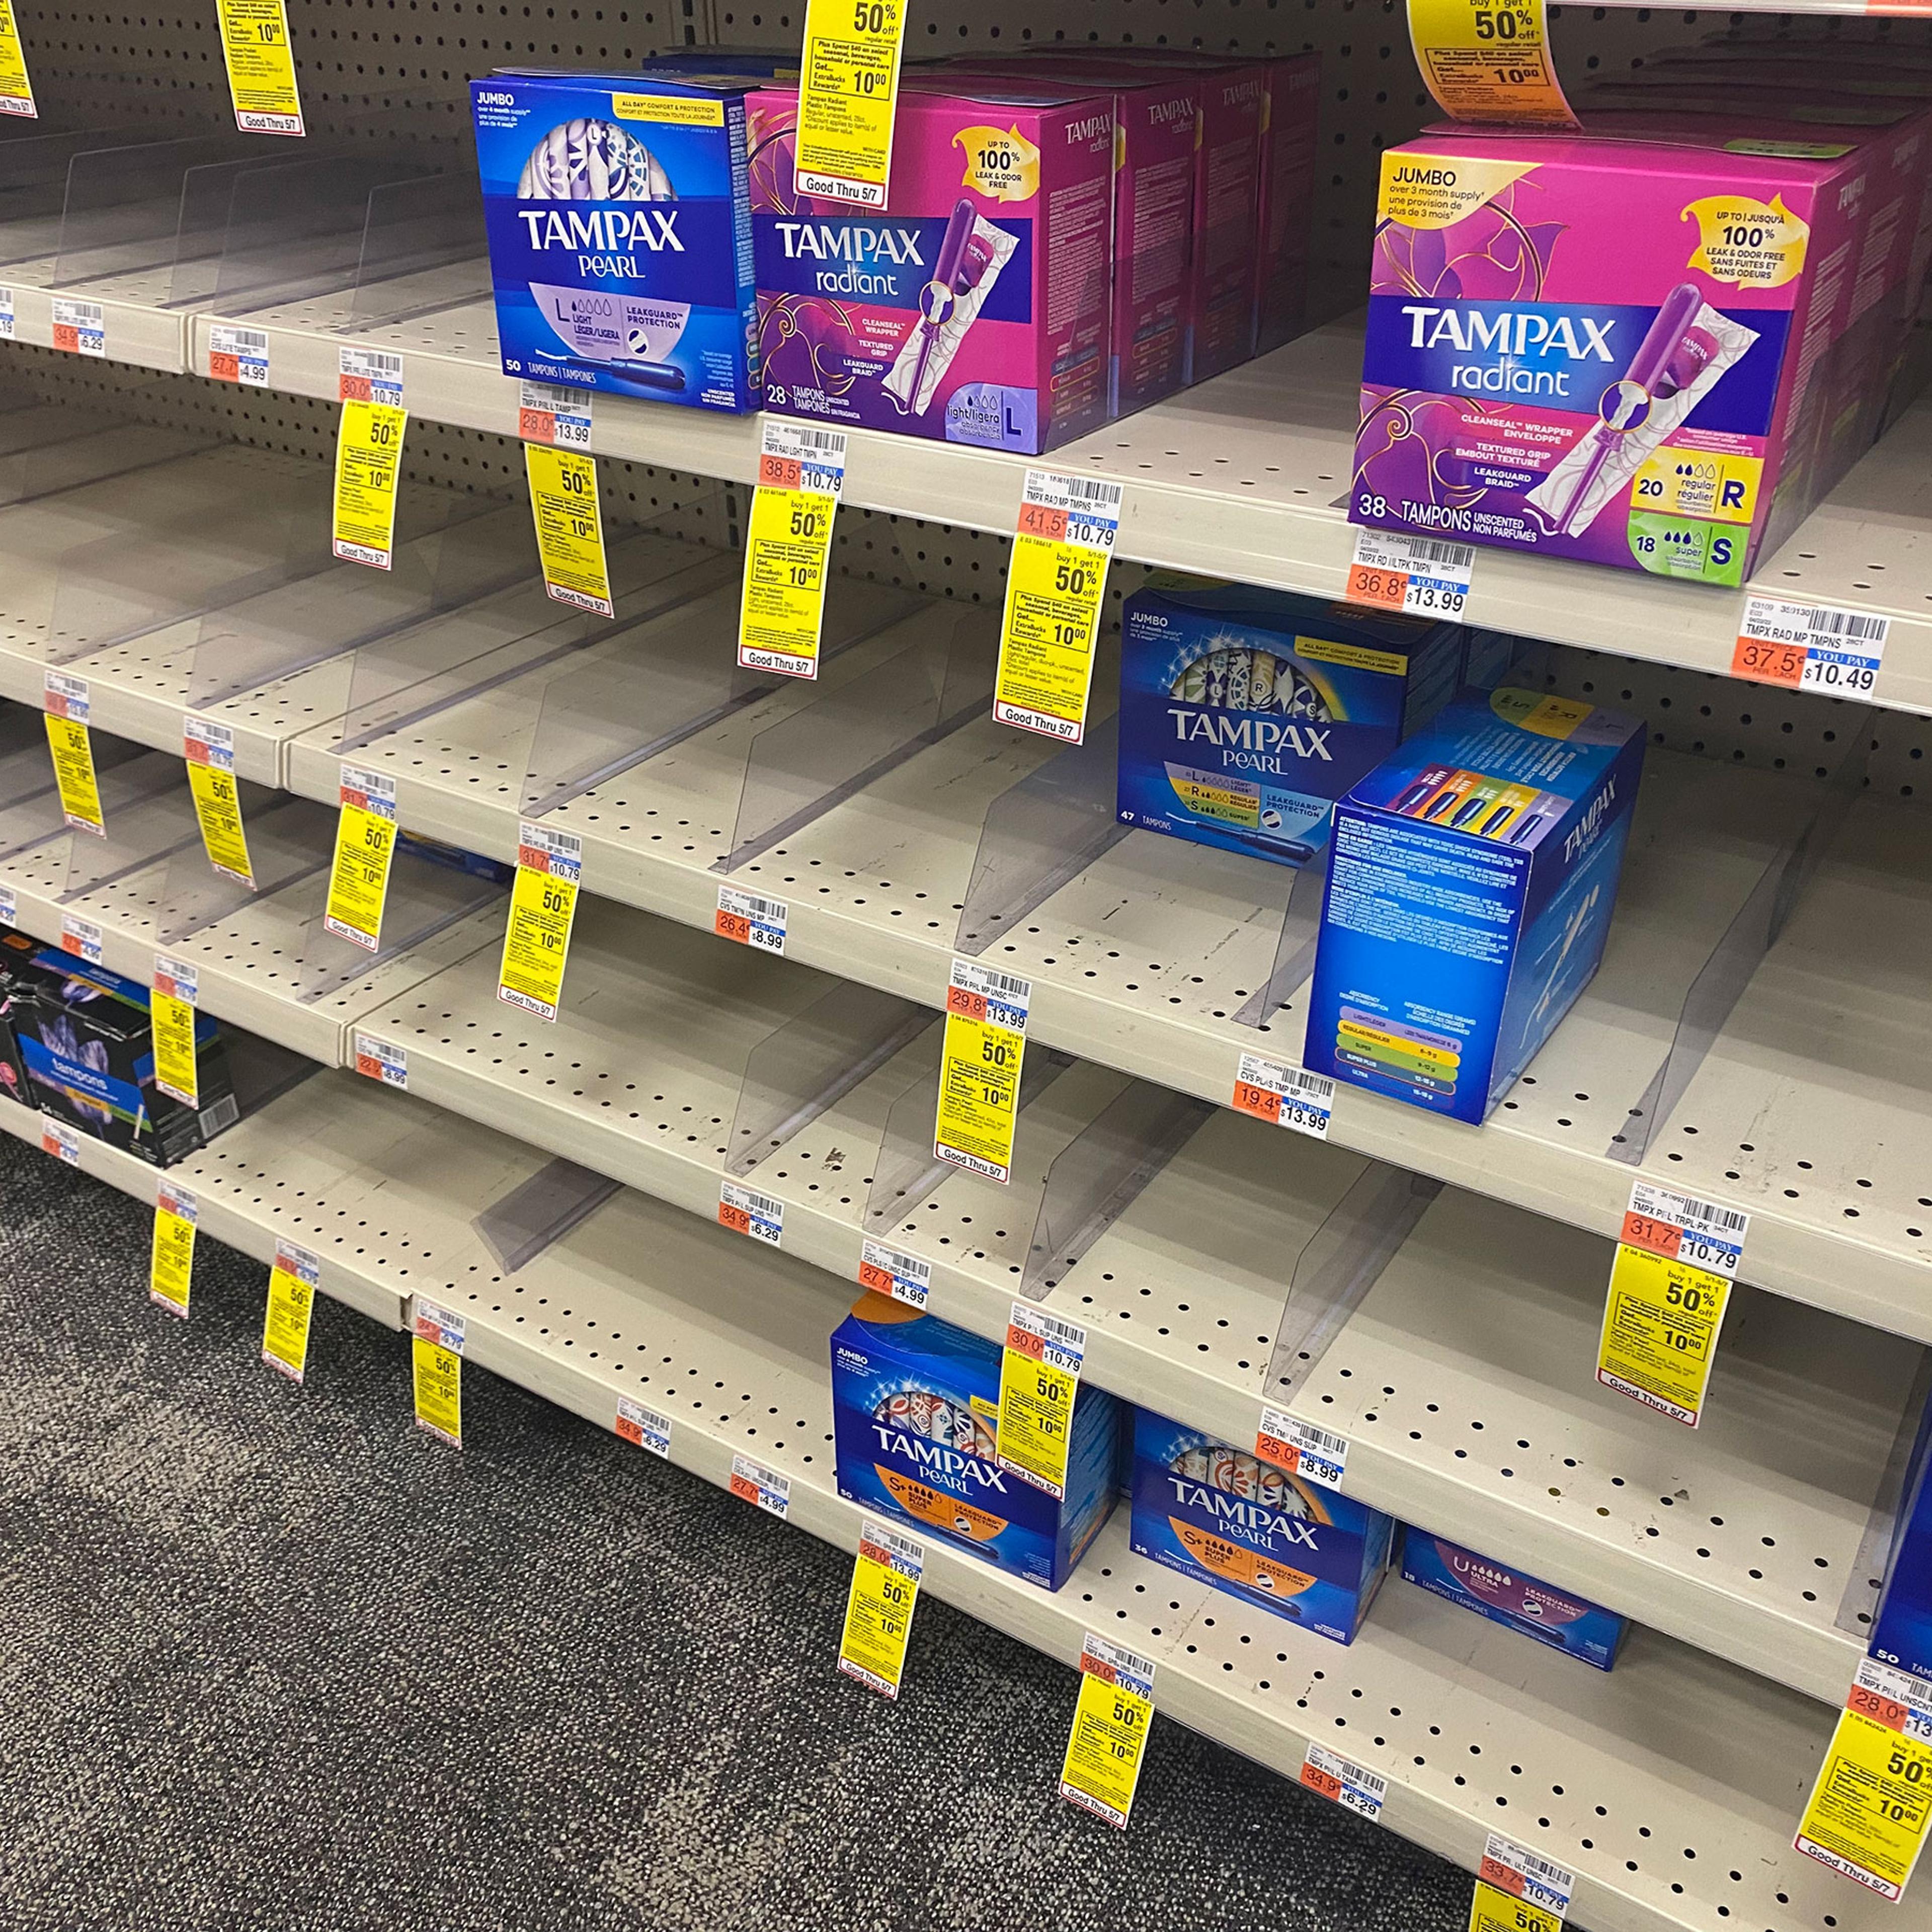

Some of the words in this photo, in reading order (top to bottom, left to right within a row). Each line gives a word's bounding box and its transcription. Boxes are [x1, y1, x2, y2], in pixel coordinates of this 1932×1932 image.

[851, 60, 875, 68] personal
[477, 92, 514, 106] JUMBO
[680, 105, 715, 113] PROTECTION
[1065, 114, 1111, 144] TAMPAX
[978, 150, 1020, 170] 100%
[1001, 174, 1022, 182] ODOR
[1393, 167, 1456, 187] JUMBO
[807, 178, 833, 193] Good
[836, 183, 859, 198] Thru
[862, 188, 877, 200] 5/7
[1390, 185, 1409, 193] over
[1419, 188, 1448, 196] month
[1407, 198, 1448, 208] provision
[1450, 202, 1462, 210] de
[1731, 213, 1741, 221] TO
[1747, 214, 1785, 224] JUSQU'À
[518, 211, 685, 251] TAMPAX
[1723, 226, 1775, 247] 100%
[774, 222, 925, 266] TAMPAX
[1707, 248, 1728, 256] LEAK
[1737, 250, 1761, 259] ODOR
[1763, 253, 1785, 261] FREE
[1711, 258, 1733, 266] SANS
[1735, 260, 1764, 268] FUITES
[816, 263, 899, 295] radiant
[1712, 268, 1735, 276] SANS
[1737, 270, 1771, 279] ODEURS
[556, 298, 570, 322] L
[572, 314, 592, 325] LIGHT
[628, 315, 680, 329] PROTECTION
[865, 326, 899, 337] WRAPPER
[1402, 306, 1616, 363] TAMPAX
[858, 340, 894, 351] TEXTURED
[506, 359, 521, 371] 50
[528, 363, 557, 378] TAMPONS
[562, 367, 596, 384] TAMPONES
[843, 359, 883, 371] LEAKGUARD
[1452, 357, 1570, 396] radiant
[767, 384, 786, 405] 28
[792, 385, 825, 401] TAMPONS
[793, 397, 830, 414] TAMPONES
[947, 405, 999, 423] light/ligera
[1006, 408, 1021, 436] L
[1525, 423, 1573, 437] WRAPPER
[1504, 430, 1561, 444] ENVELOPPE
[1456, 448, 1495, 460] EMBOUT
[1497, 454, 1540, 467] TEXTURÉ
[1477, 442, 1525, 455] TEXTURED
[1527, 451, 1551, 459] GRIP
[801, 474, 841, 492] $10.79
[1474, 467, 1532, 482] LEAKGUARD
[1026, 490, 1043, 502] TMPX
[1044, 494, 1058, 504] RAD
[1060, 497, 1069, 506] MP
[1070, 500, 1091, 511] TMPNS
[1639, 479, 1663, 496] 20
[1681, 479, 1716, 491] regular
[1721, 480, 1745, 509] R
[1074, 513, 1091, 524] YOU
[1092, 518, 1110, 527] PAY
[1358, 494, 1386, 517] 38
[1402, 501, 1471, 531] TAMPONS
[1474, 513, 1524, 529] UNSCENTED
[1067, 524, 1114, 546] $10.79
[1473, 523, 1491, 534] NON
[1493, 526, 1537, 542] PARFUMÉS
[1637, 536, 1655, 552] 18
[1676, 546, 1702, 557] super
[1711, 538, 1732, 565] S
[1358, 552, 1376, 562] TMPX
[1377, 556, 1387, 566] RD
[1412, 562, 1431, 573] TMPN
[1416, 578, 1439, 589] YOU
[1440, 582, 1460, 592] PAY
[1406, 587, 1463, 612] $13.99
[1131, 612, 1168, 627] JUMBO
[1746, 623, 1770, 637] TMPX
[1772, 628, 1792, 640] RAD
[1793, 632, 1808, 642] MP
[1810, 634, 1841, 649] TMPNS
[1805, 663, 1873, 690] $10.49
[1006, 708, 1033, 726] Good
[1034, 715, 1057, 732] Thru
[1058, 721, 1073, 736] 5/7
[1167, 708, 1333, 761] TAMPAX
[1266, 802, 1320, 817] PROTECTION
[1120, 811, 1135, 820] 47
[1143, 816, 1171, 830] TAMPONS
[752, 933, 782, 948] $8.99
[987, 1007, 1025, 1029] $13.99
[1241, 1071, 1254, 1082] CVS
[1275, 1082, 1289, 1092] TMP
[1291, 1088, 1300, 1096] MP
[1280, 1107, 1326, 1131] $13.99
[751, 1224, 778, 1241] $6.29
[1680, 1242, 1737, 1269] $10.79
[895, 1285, 924, 1304] $4.99
[837, 1347, 868, 1365] JUMBO
[1044, 1348, 1081, 1372] $10.79
[1610, 1378, 1639, 1398] Good
[1642, 1393, 1668, 1412] Thru
[1670, 1406, 1687, 1420] 5/7
[1263, 1424, 1274, 1433] CVS
[1290, 1435, 1303, 1445] UNS
[1304, 1441, 1317, 1450] SUP
[871, 1424, 1007, 1494] TAMPAX
[1301, 1460, 1338, 1482] $8.99
[840, 1489, 853, 1499] 50
[908, 1491, 932, 1506] SUPER
[909, 1498, 927, 1510] PLUS
[1168, 1477, 1319, 1551] TAMPAX
[1205, 1546, 1230, 1561] SUPER
[1205, 1553, 1225, 1564] PLUS
[1454, 1556, 1469, 1572] U
[1470, 1571, 1499, 1588] ULTRA
[1876, 1649, 1899, 1664] 50
[1342, 1793, 1377, 1814] $6.29
[1808, 1846, 1840, 1867] Good
[1842, 1861, 1870, 1884] Thru
[1872, 1878, 1890, 1893] 5/7
